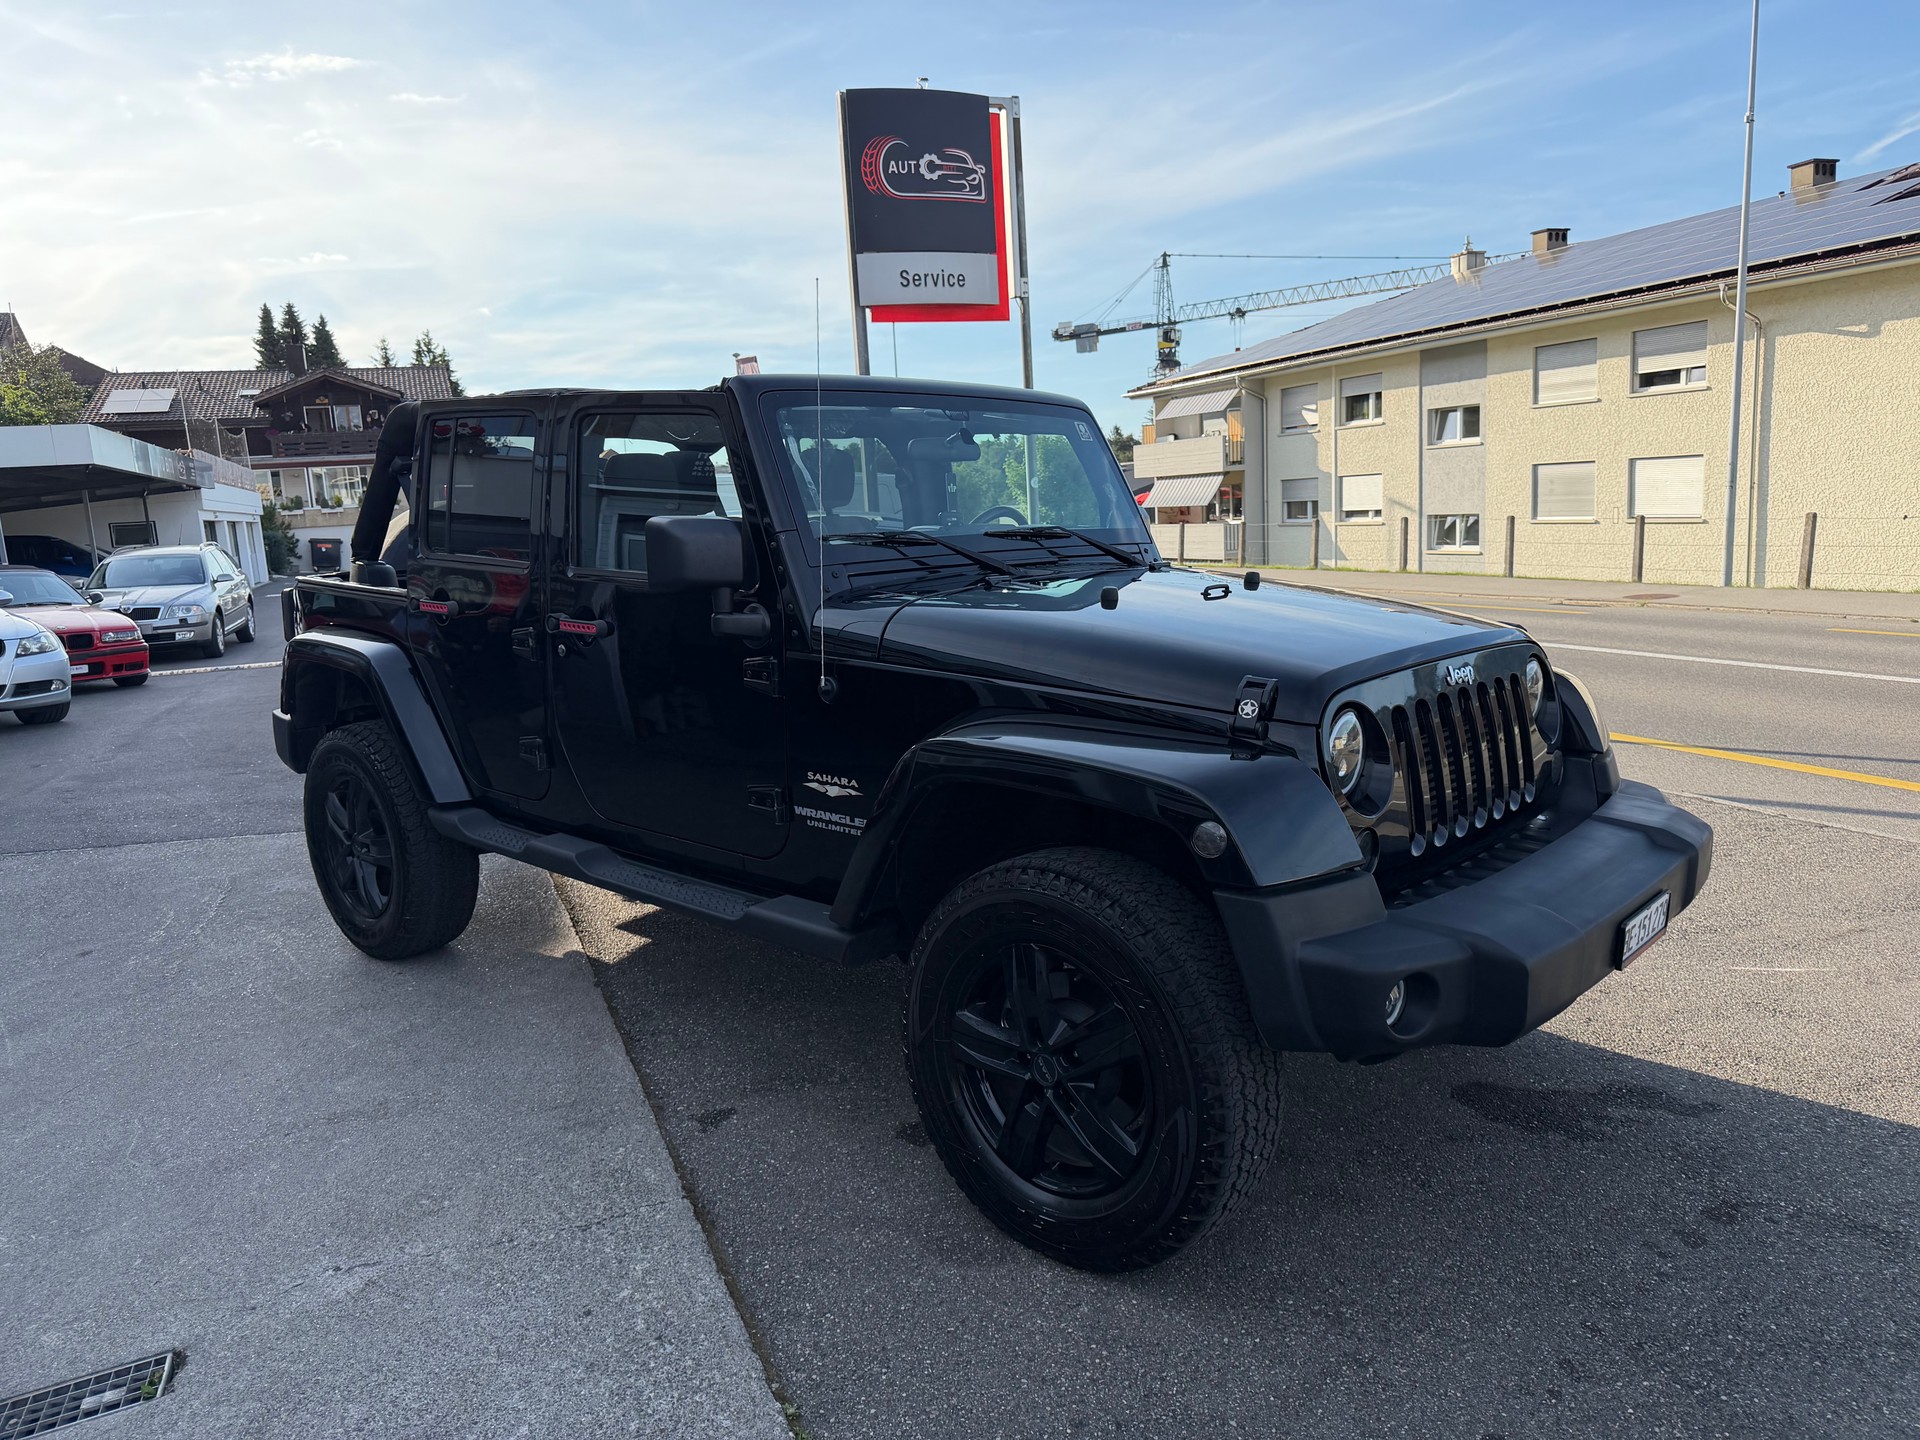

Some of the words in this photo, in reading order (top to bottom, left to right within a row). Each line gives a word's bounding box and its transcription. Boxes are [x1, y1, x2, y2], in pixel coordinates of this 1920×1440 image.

[899, 269, 966, 288] Service
[1446, 665, 1475, 686] Jeep
[807, 771, 859, 788] SAHARA
[793, 805, 868, 828] WRANGLE
